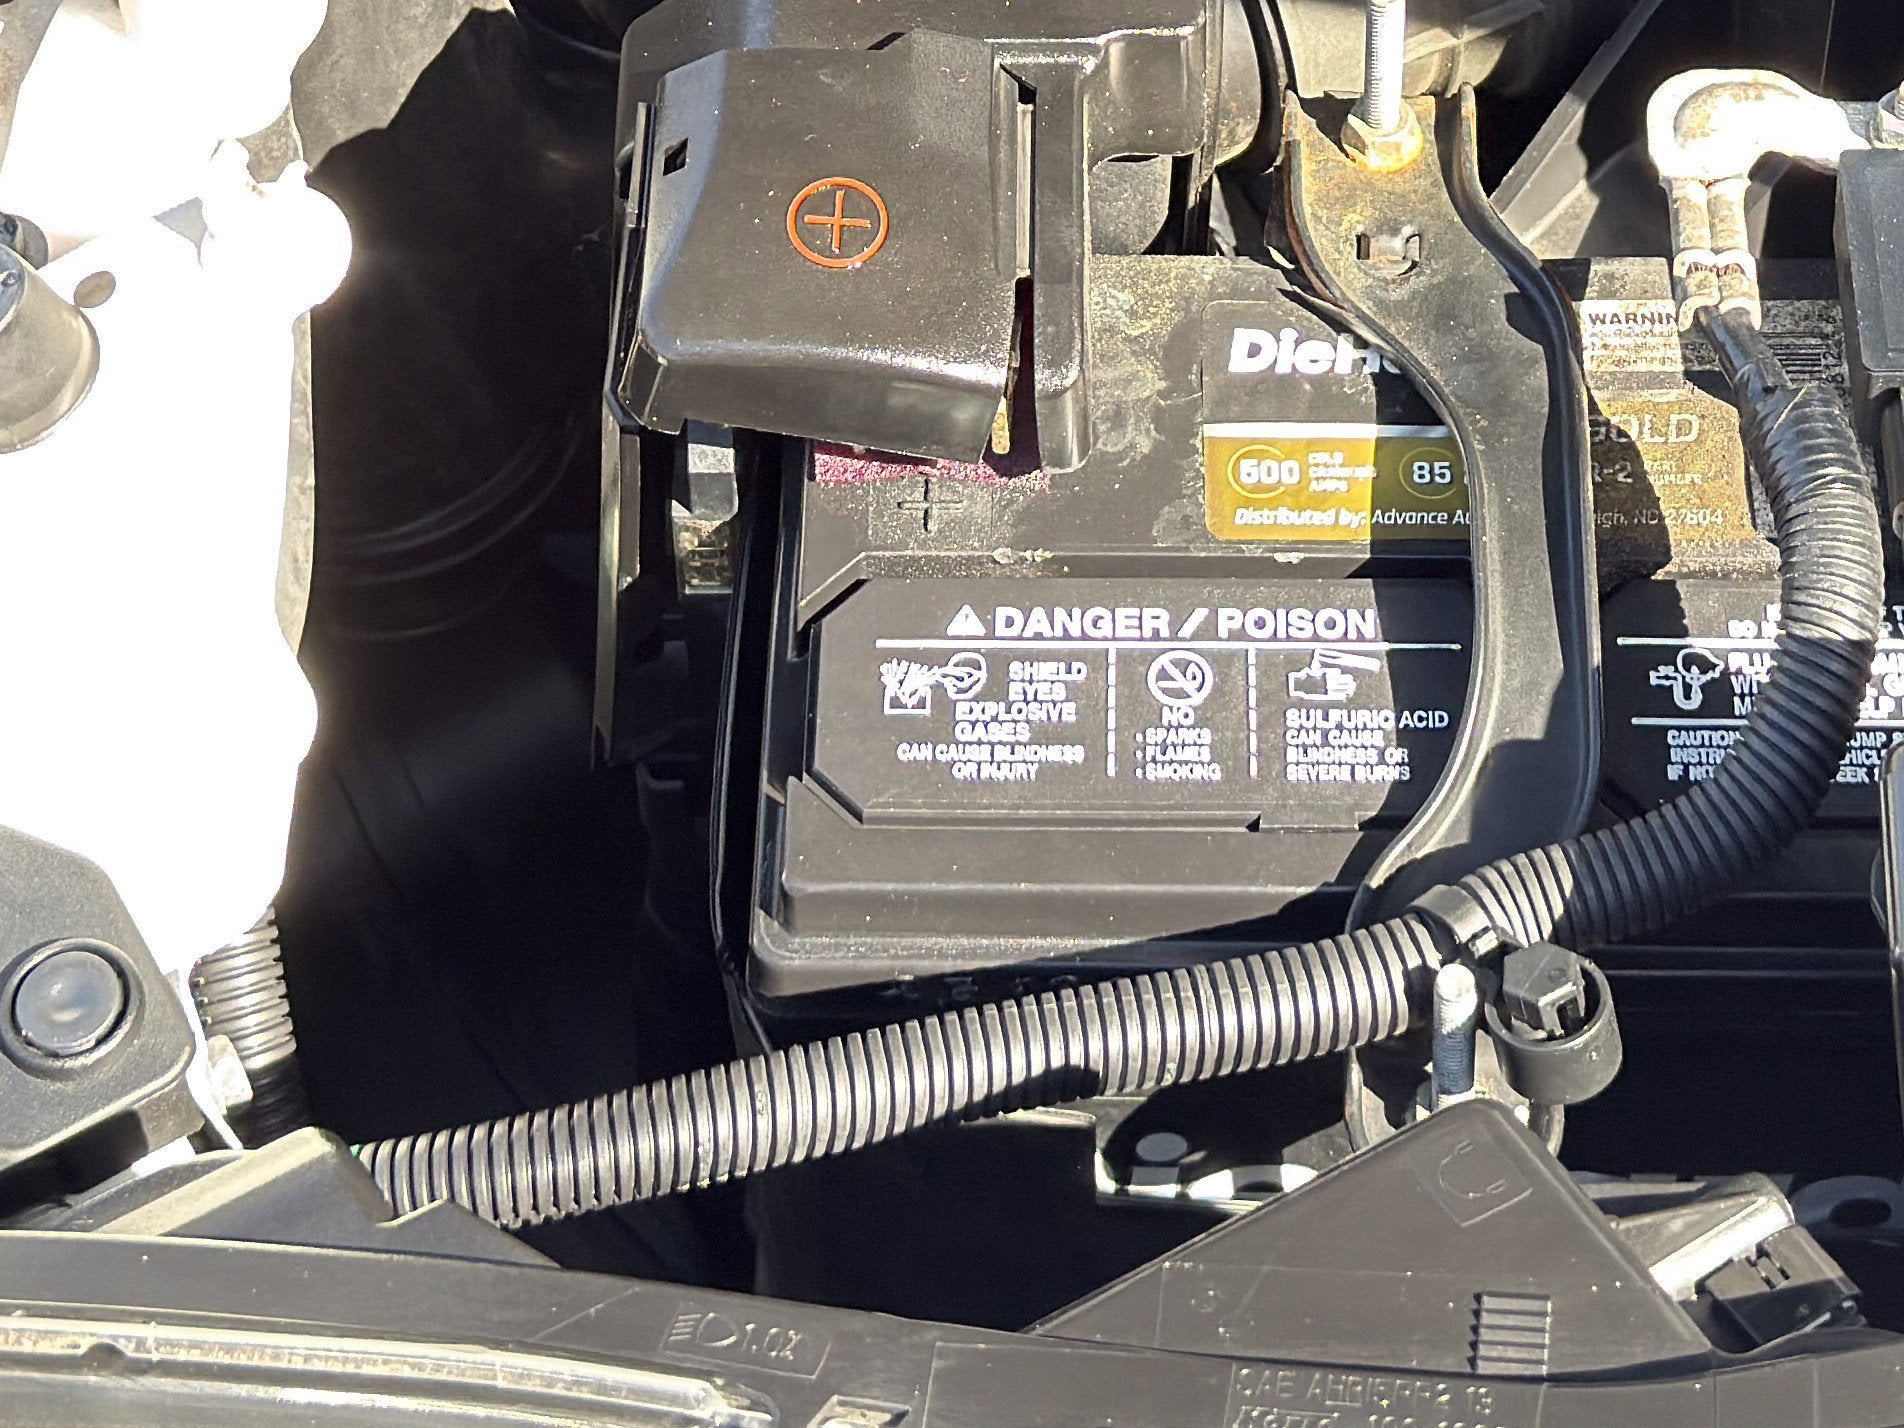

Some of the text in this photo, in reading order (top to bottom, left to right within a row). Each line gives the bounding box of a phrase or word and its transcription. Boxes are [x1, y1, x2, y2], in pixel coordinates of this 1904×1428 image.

[1589, 312, 1679, 325] WARNIN
[1228, 328, 1402, 374] DieH
[1412, 461, 1452, 484] 85
[1235, 506, 1336, 526] Distributed
[1371, 508, 1447, 525] Advance
[1452, 508, 1470, 525] Au
[994, 606, 1170, 638] DANGER
[1217, 607, 1375, 639] POISON
[1008, 661, 1087, 681] SHIELD
[1008, 682, 1067, 701] EYES
[955, 701, 1077, 721] EXPLOSIVE
[1161, 705, 1195, 725] NO
[1285, 709, 1449, 729] SULFURIC ACID
[954, 721, 1031, 742] GASES
[1145, 727, 1211, 744] SPARKS
[1286, 729, 1384, 746] CAN CAUSE
[896, 743, 933, 761] CAN
[1145, 745, 1211, 762] FLAMES
[1383, 747, 1409, 763] OR
[1145, 763, 1222, 781] SMOKING
[1354, 764, 1411, 782] BURNS
[1667, 765, 1683, 780] IF
